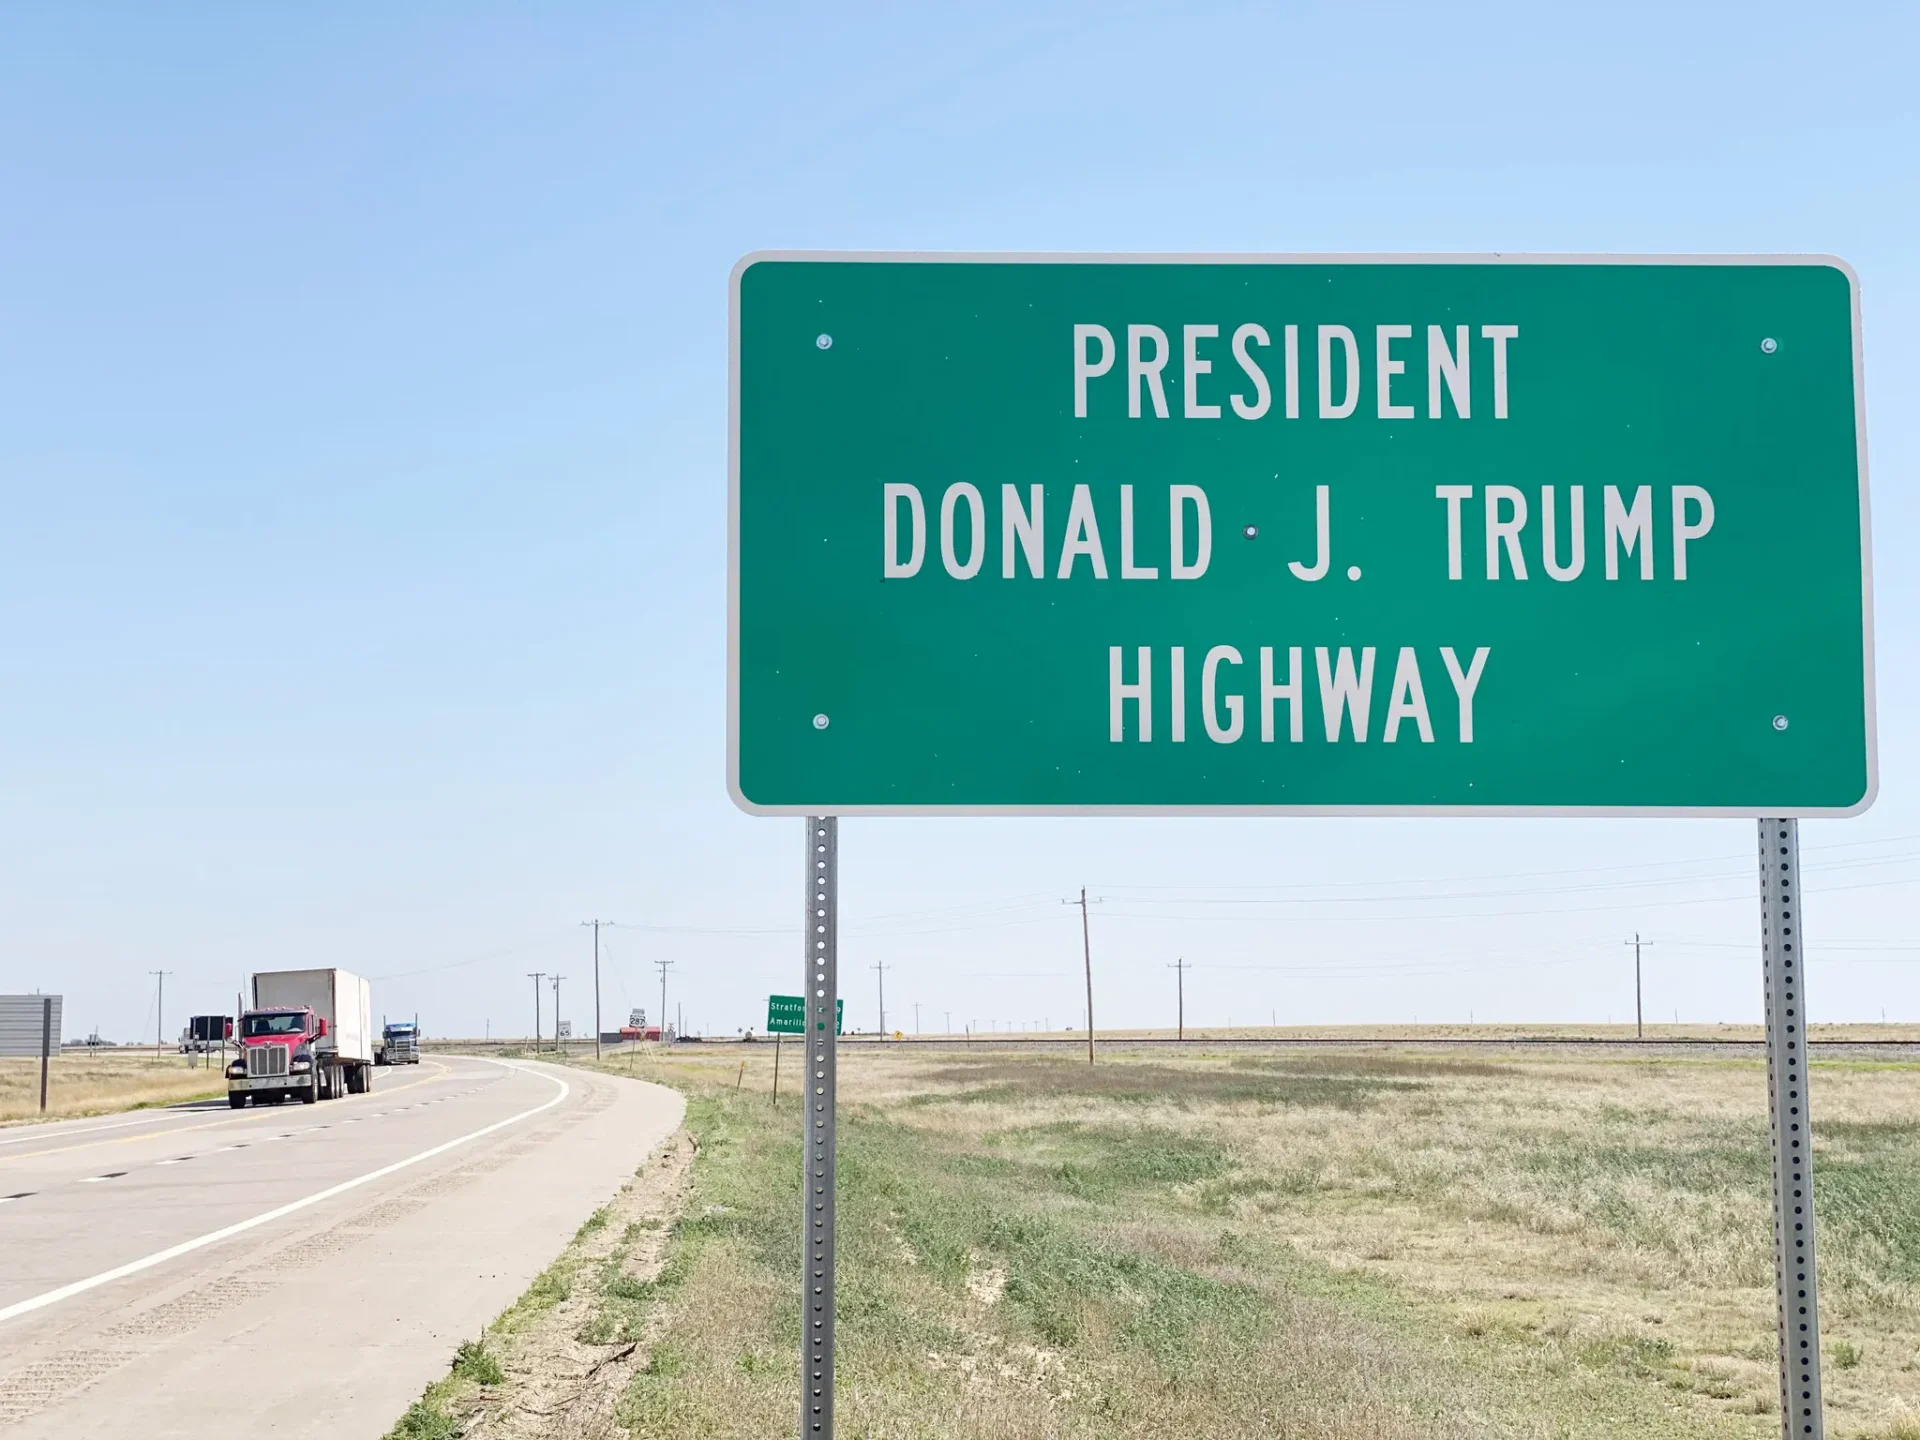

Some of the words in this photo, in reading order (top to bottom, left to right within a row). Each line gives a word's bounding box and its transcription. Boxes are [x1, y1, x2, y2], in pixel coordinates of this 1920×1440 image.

[1073, 323, 1519, 420] PRESIDENT
[883, 481, 1212, 580] DONALD
[1287, 485, 1362, 582] J.
[1435, 485, 1716, 582] TRUMP
[1109, 644, 1491, 744] HIGHWAY
[630, 1017, 645, 1026] 287
